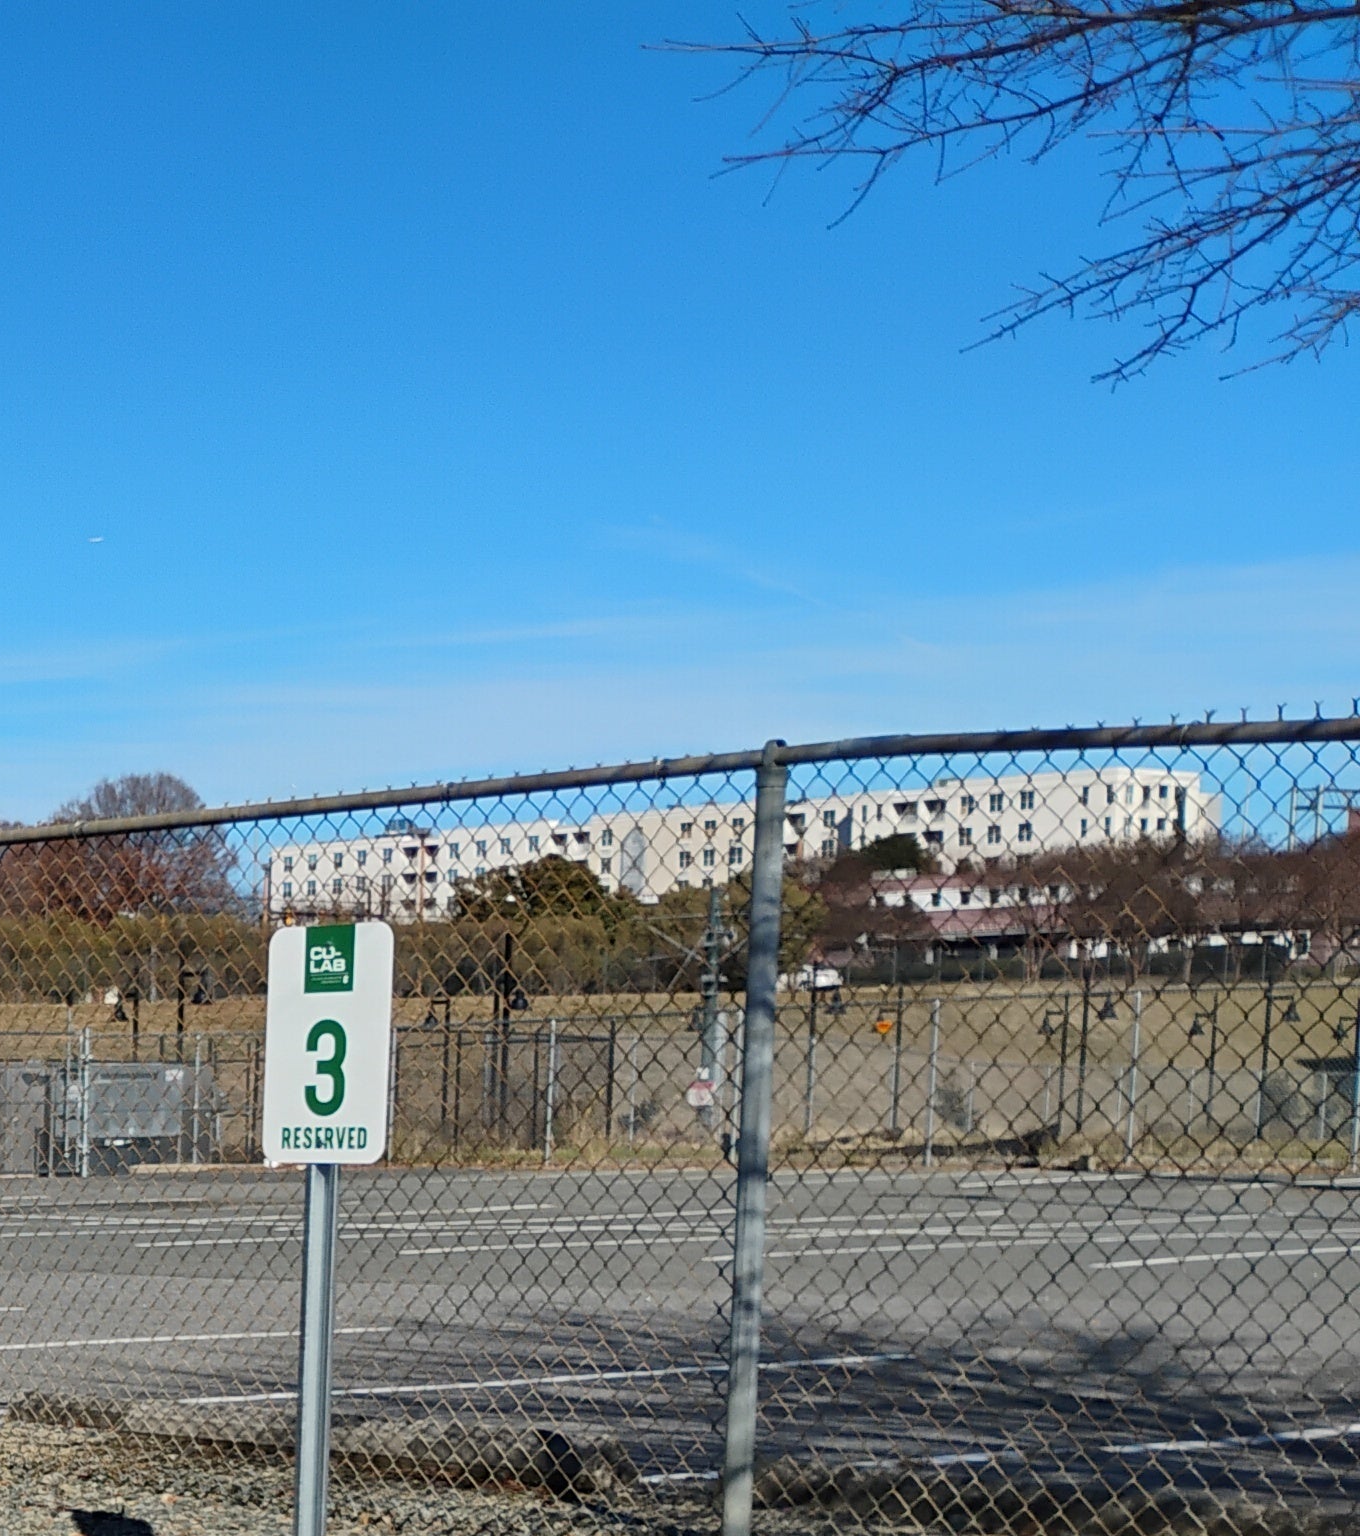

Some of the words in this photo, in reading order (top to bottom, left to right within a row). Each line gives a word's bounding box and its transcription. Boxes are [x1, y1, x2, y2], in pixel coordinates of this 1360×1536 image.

[310, 958, 346, 973] LAB
[304, 1019, 347, 1116] 3
[281, 1127, 367, 1149] RESERVED
